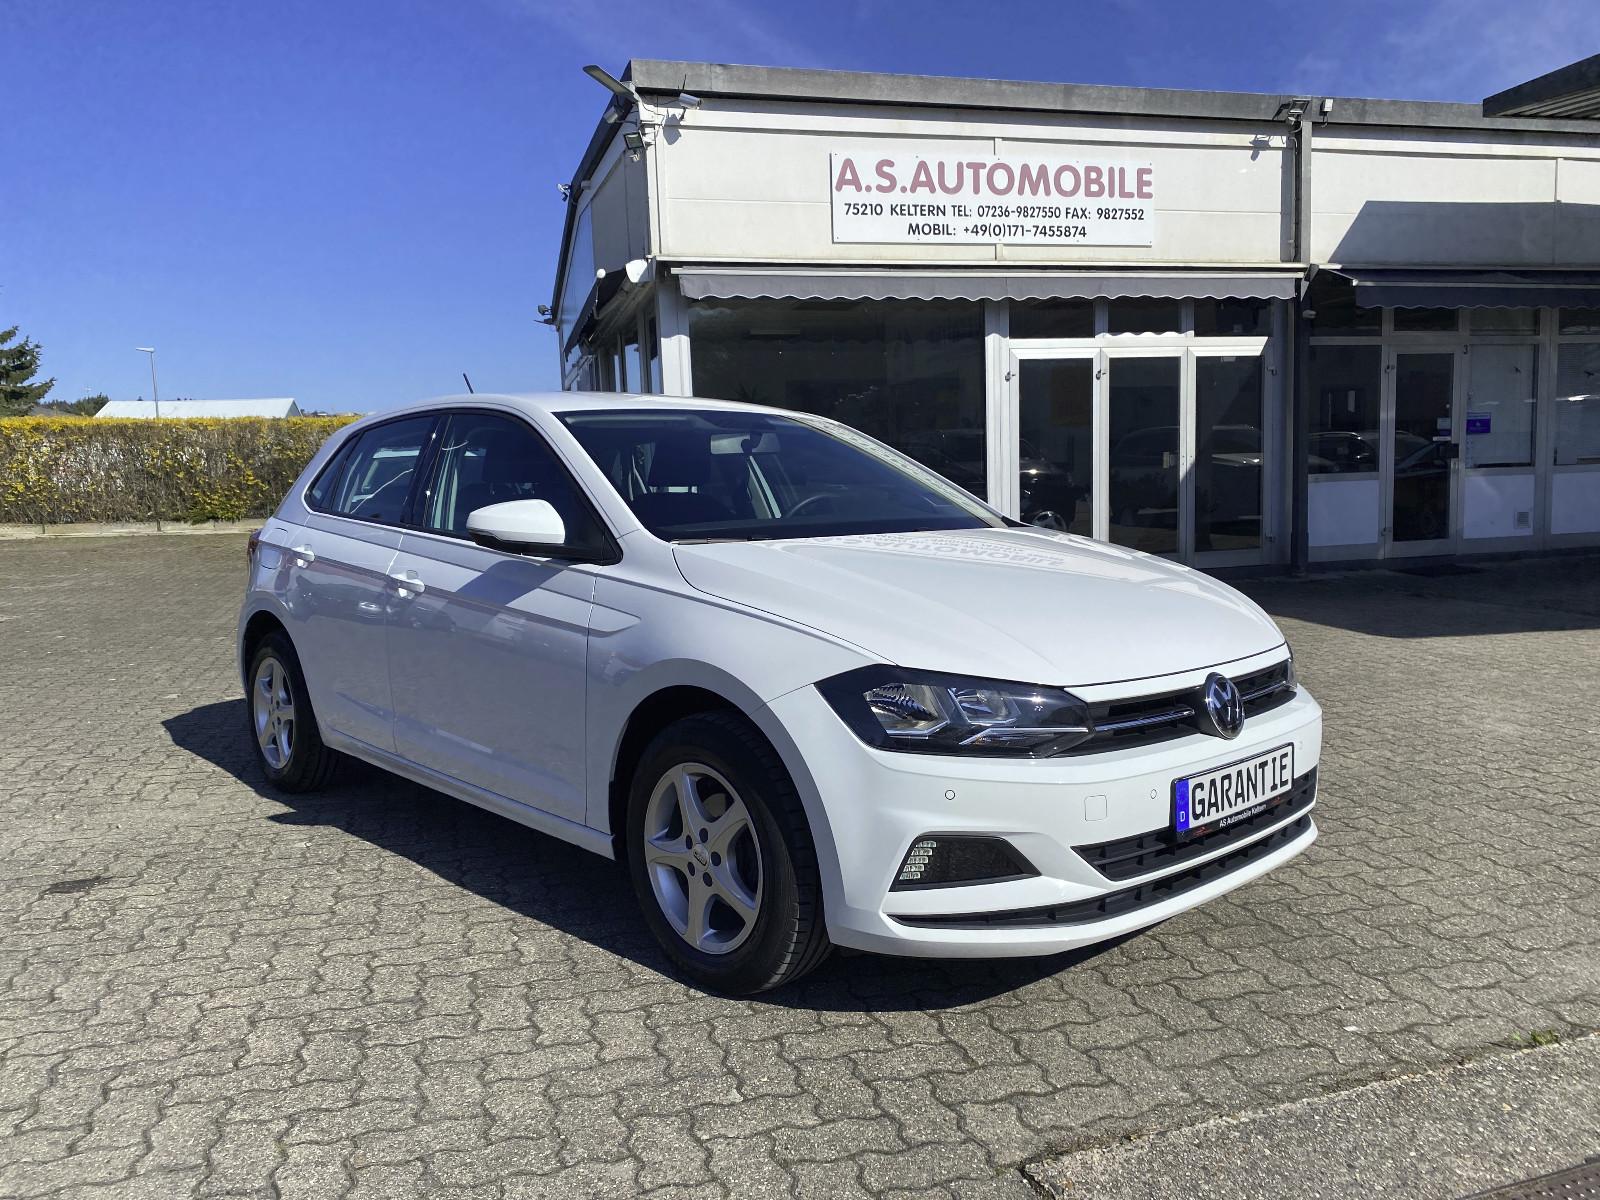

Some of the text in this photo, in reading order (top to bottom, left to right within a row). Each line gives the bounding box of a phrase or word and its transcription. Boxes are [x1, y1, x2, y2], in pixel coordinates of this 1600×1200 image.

[835, 158, 1154, 199] A.S.AUTOMOBILE
[844, 203, 1145, 221] 75210 KELTERN TEL: 07236-9827550 FAX: 9827552
[907, 223, 1087, 239] MOBIL: +49(0)171-7455874
[1191, 751, 1289, 821] GARANTIE
[1179, 811, 1186, 822] D
[1219, 818, 1227, 828] AS
